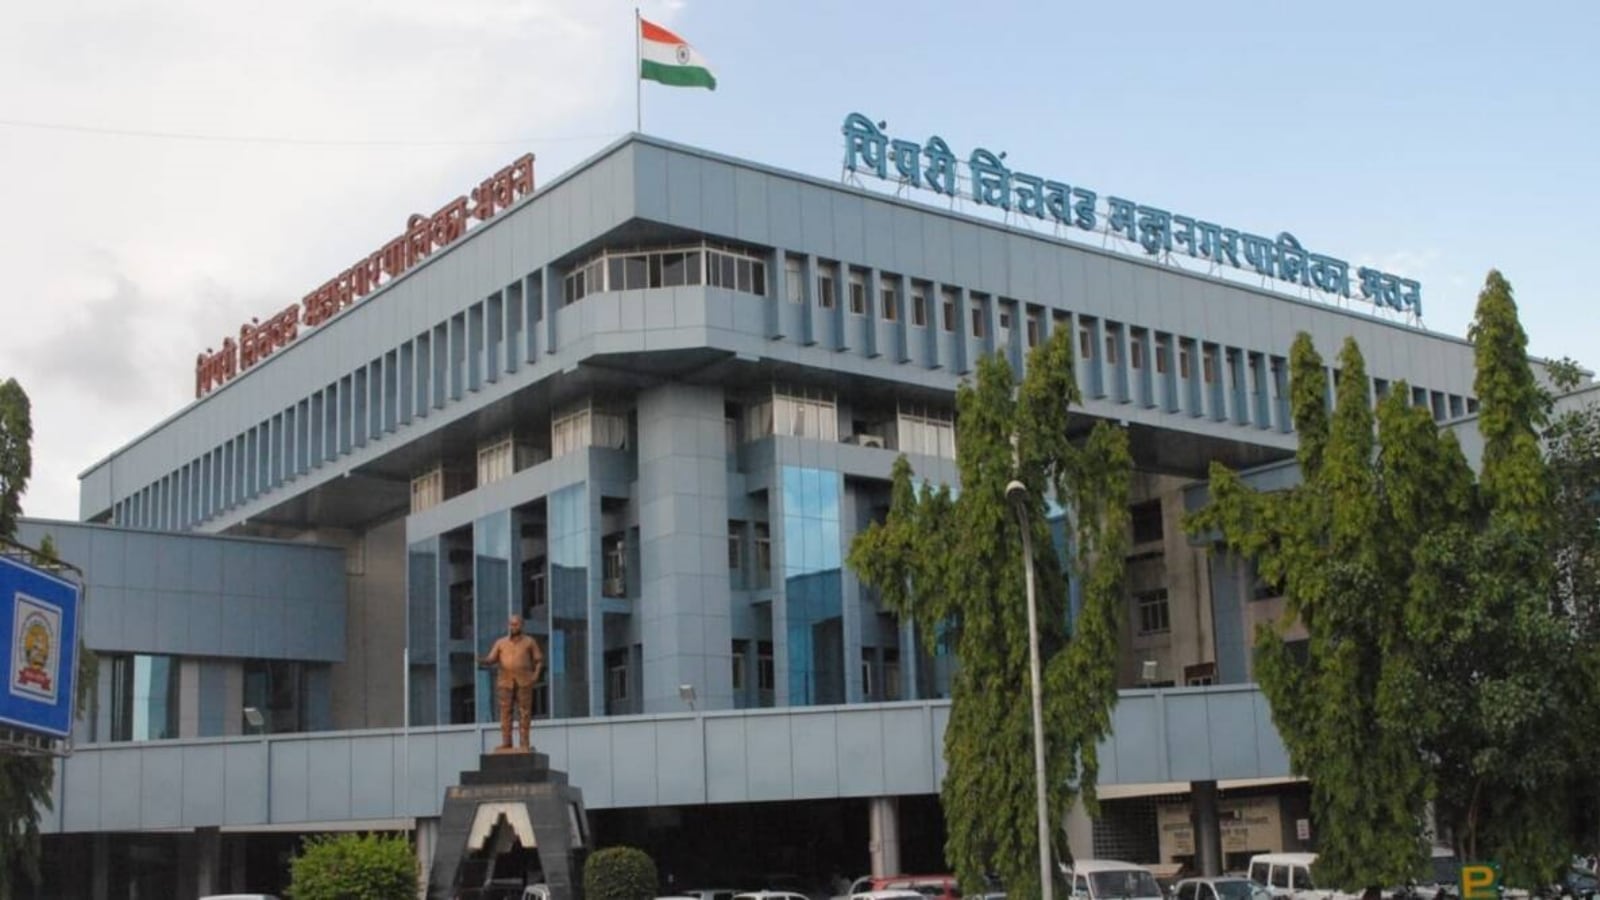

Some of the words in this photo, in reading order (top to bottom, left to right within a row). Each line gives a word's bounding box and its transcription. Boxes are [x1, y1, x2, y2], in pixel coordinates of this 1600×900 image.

[196, 336, 237, 399] पिंपरी
[240, 303, 300, 371] चिंचवड
[302, 195, 468, 326] महानगरपालिका
[463, 152, 535, 221] भवन
[842, 112, 957, 196] पिंपरी
[970, 148, 1097, 230] चिंचवड
[1107, 196, 1350, 299] महानगरपालिका
[1358, 266, 1422, 317] भवन
